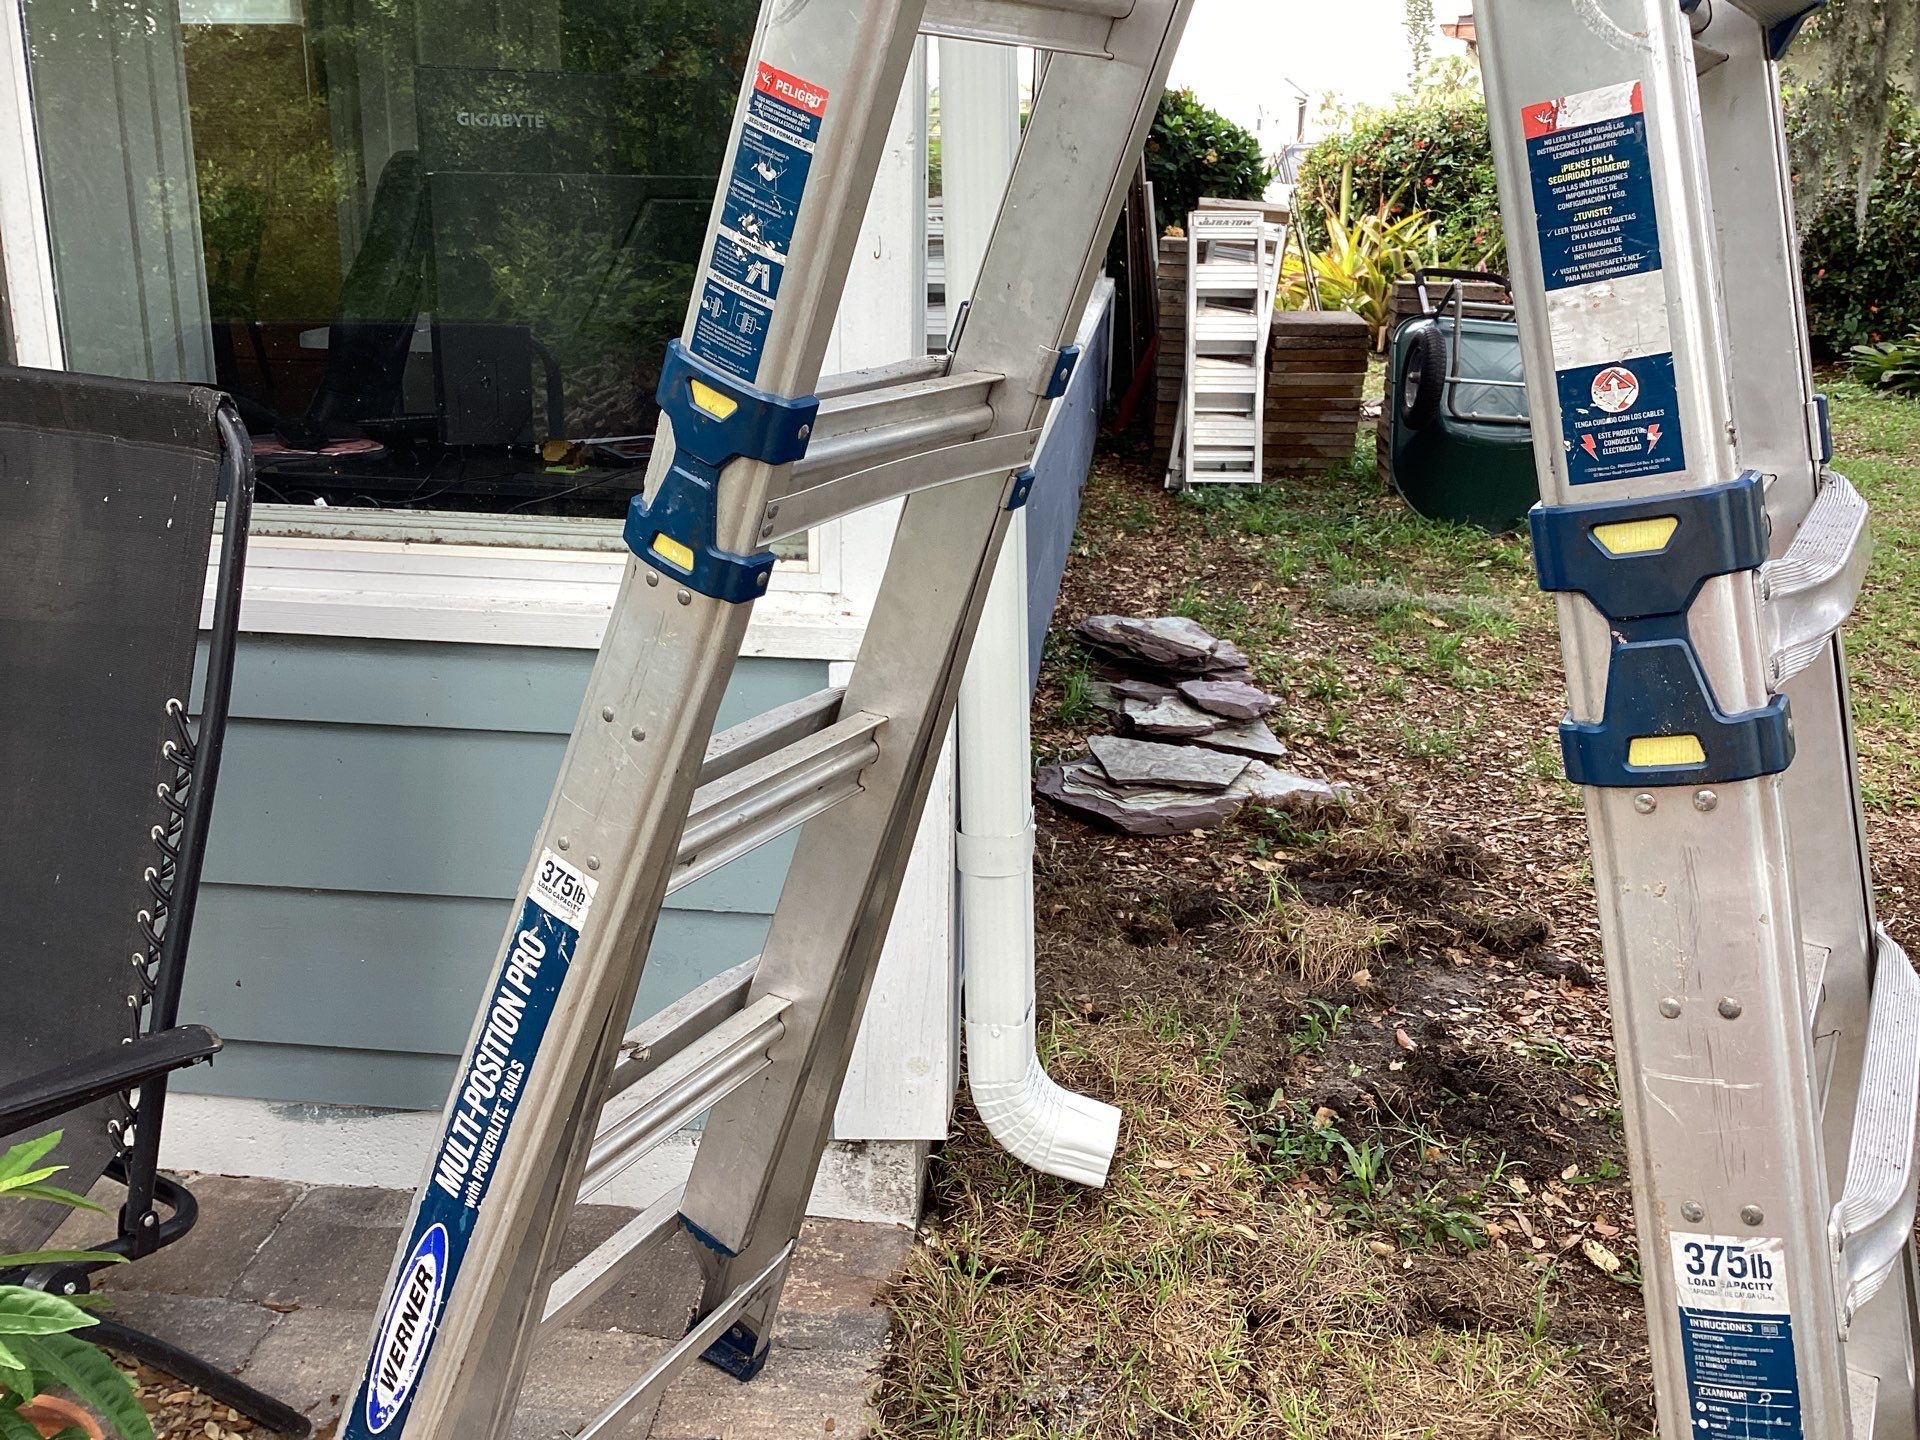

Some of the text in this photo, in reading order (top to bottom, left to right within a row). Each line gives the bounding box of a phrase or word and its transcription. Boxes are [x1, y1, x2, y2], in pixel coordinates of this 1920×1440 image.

[775, 79, 820, 108] PELIGRO
[456, 111, 544, 128] GIGABYTE
[777, 130, 793, 141] FORMA
[1537, 127, 1634, 156] INSTRUCCIONES PODRÍA PROVOCAR
[1553, 136, 1567, 144] LEER
[1572, 130, 1592, 140] SEGUIR
[1593, 124, 1612, 134] TODAS
[1613, 122, 1624, 130] LAS
[1553, 149, 1579, 160] LESIONES
[1593, 140, 1619, 150] MUERTE.
[1548, 160, 1630, 185] SEGURIDAD PRIMERO!
[1561, 154, 1614, 173] ¡PIENSE EN LA
[1552, 172, 1628, 195] SIGA LAS INSTRUCCIONES
[1565, 185, 1608, 200] IMPORTANTES
[1557, 193, 1606, 211] CONFIGURACIÓN
[1573, 206, 1613, 222] ¿TUVISTE?
[1554, 213, 1637, 236] LEER TODAS LAS ETIQUETAS
[1580, 231, 1589, 239] LA
[1589, 225, 1620, 237] ESCALERA
[1571, 244, 1587, 253] LEER
[1587, 239, 1613, 249] MANUAL
[1574, 245, 1623, 260] INSTRUCCIONES
[1560, 253, 1640, 275] VISITA WERNERSAFETY.NET
[1565, 263, 1639, 282] PARA MÁS INFORMACIÓN
[713, 273, 768, 304] PERILLAS DE PRESIONAR
[1575, 409, 1665, 429] TENGA CUIDADO CON LOS CABLES
[1598, 427, 1644, 439] ESTE PRODUCTO
[1603, 437, 1630, 447] CONDUCE
[1602, 443, 1642, 455] ELECTRICIDAD
[542, 860, 585, 905] 375lb
[538, 880, 581, 912] LOAD CAPACITY
[434, 929, 546, 1199] MULTI-POSITION PRO
[464, 1179, 481, 1209] with
[500, 1058, 525, 1102] RAILS
[1684, 1242, 1772, 1280] 375lb
[1687, 1277, 1715, 1287] LOAD
[380, 1264, 433, 1393] WERNER
[1690, 1319, 1753, 1333] INTRUCCIONES
[1698, 1387, 1747, 1401] ¡EXAMINAR!
